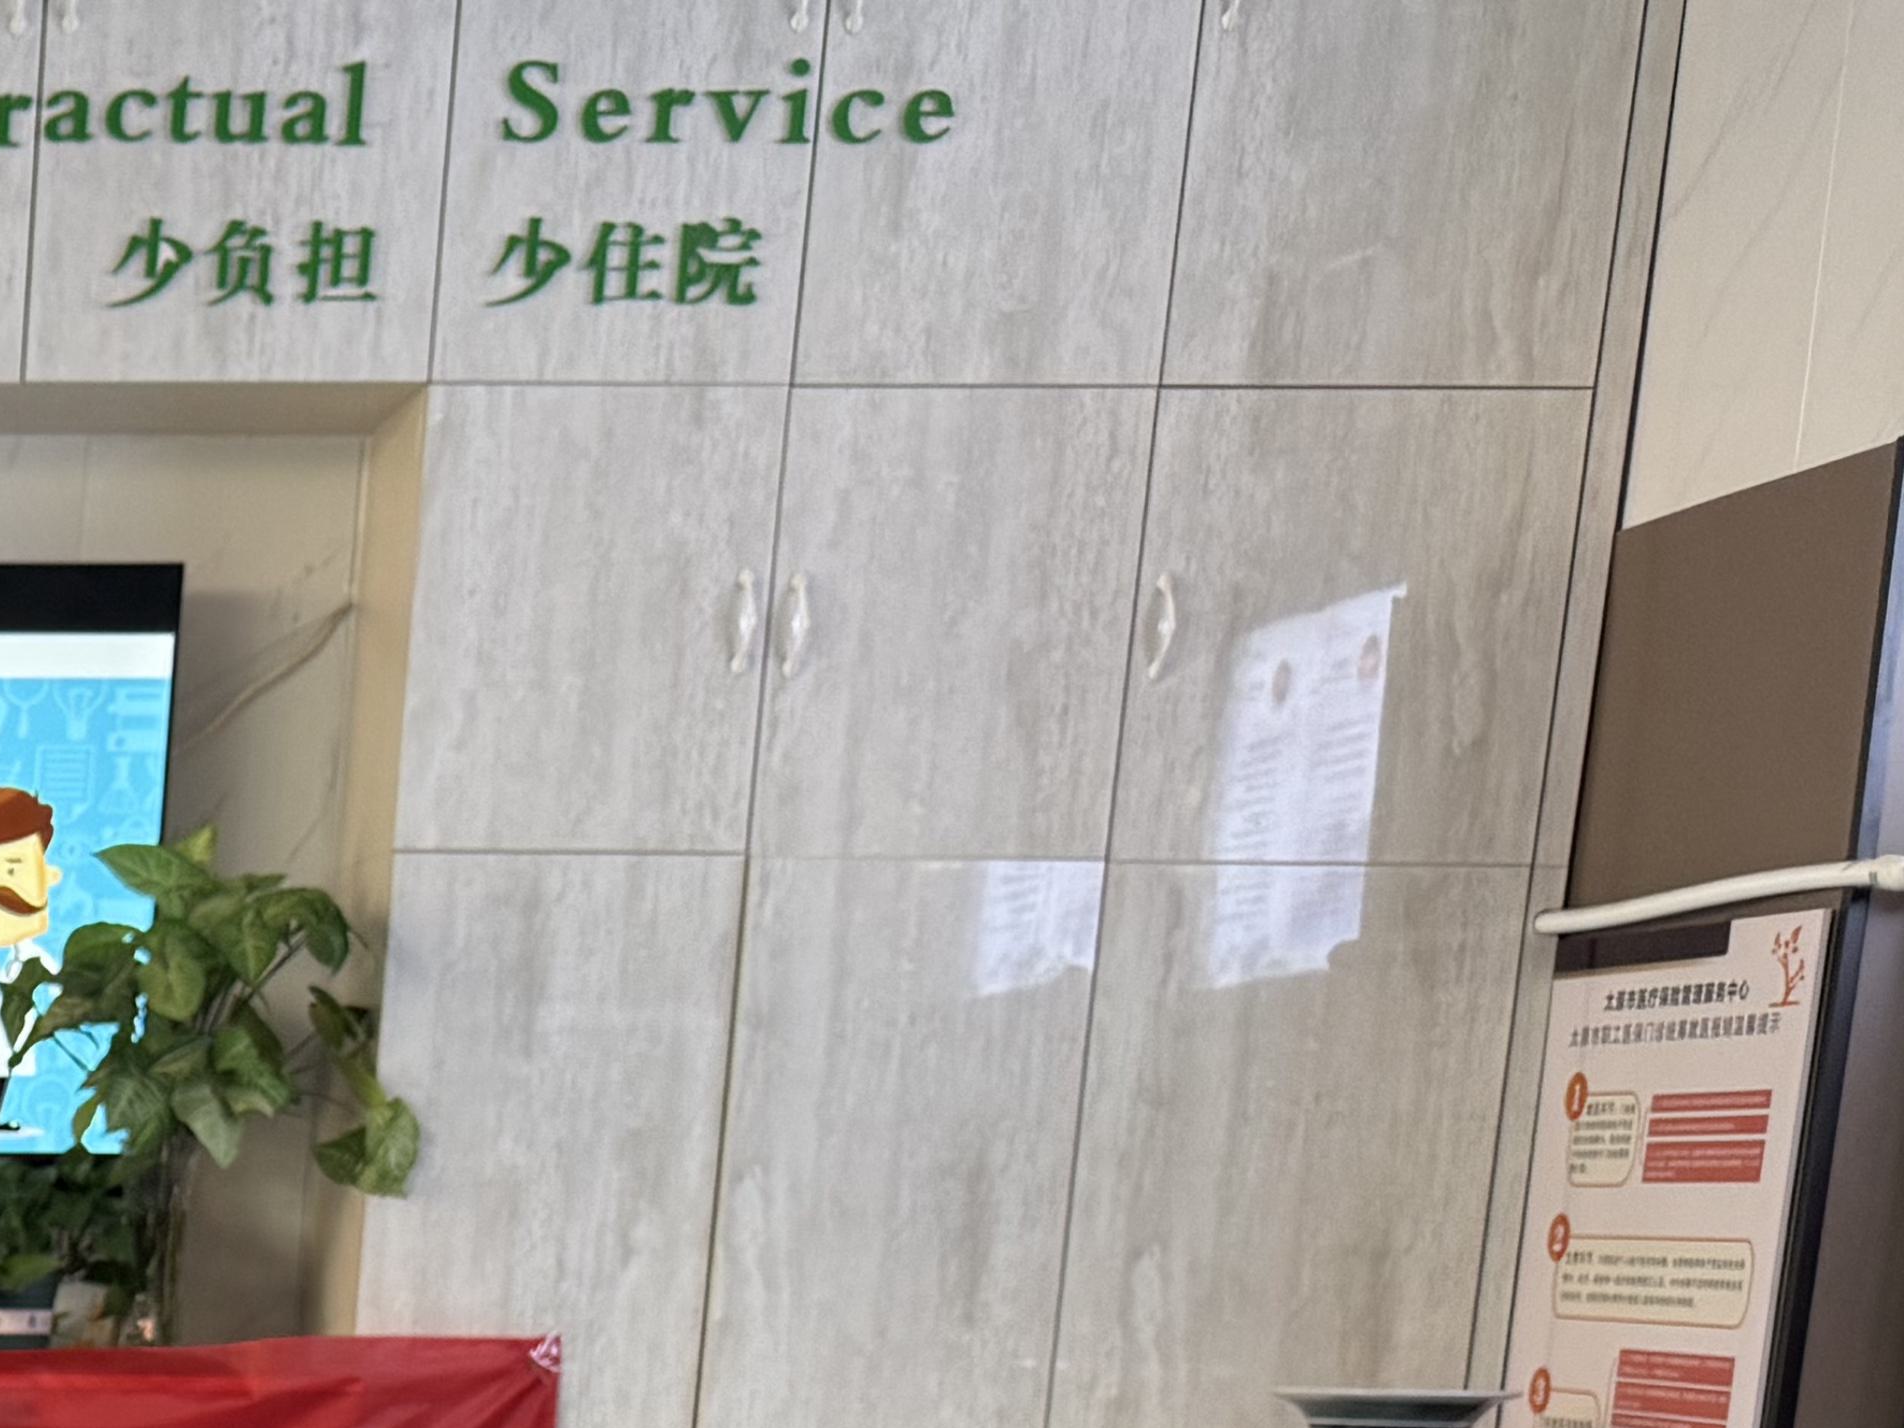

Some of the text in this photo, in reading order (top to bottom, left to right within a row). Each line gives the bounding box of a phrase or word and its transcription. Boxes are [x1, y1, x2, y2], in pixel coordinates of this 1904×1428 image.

[501, 58, 957, 146] Service
[106, 218, 380, 309] 少负担
[486, 216, 764, 309] 少住院
